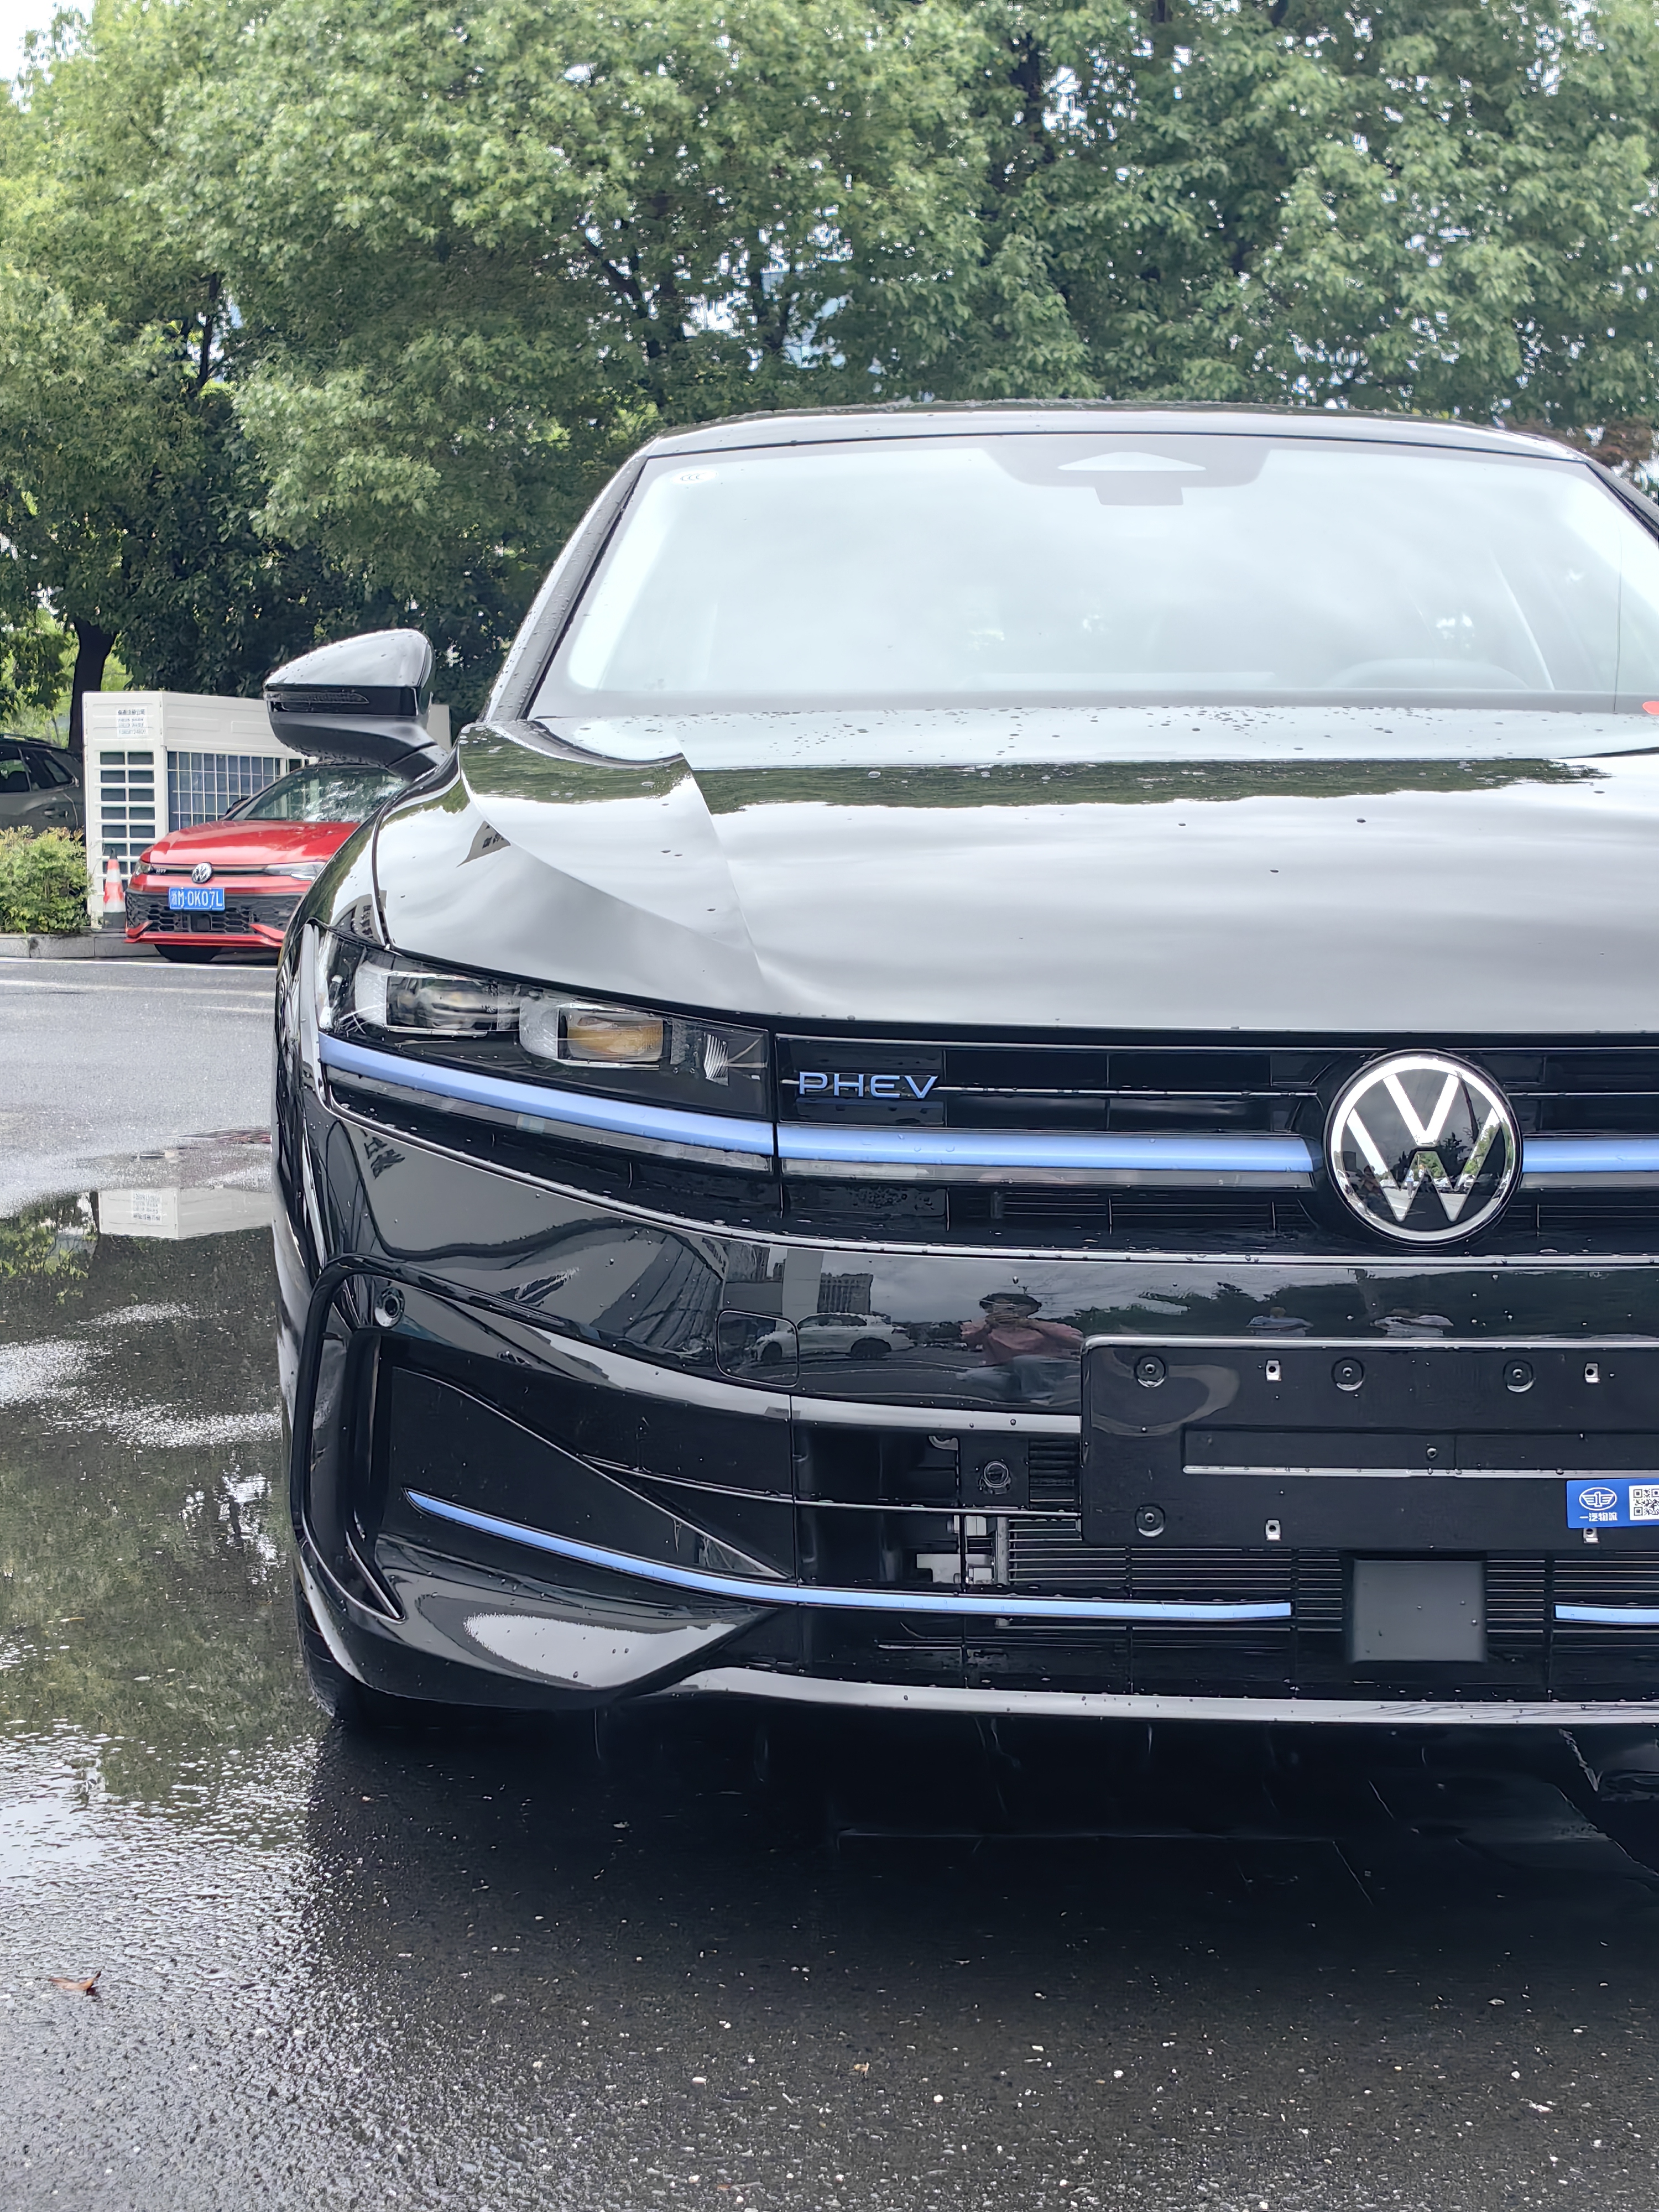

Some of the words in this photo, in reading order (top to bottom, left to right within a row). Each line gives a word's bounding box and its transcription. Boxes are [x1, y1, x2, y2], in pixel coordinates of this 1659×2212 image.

[799, 1071, 938, 1099] PHEV
[1344, 1069, 1504, 1224] VW
[1579, 1512, 1618, 1522] 一汽物流
